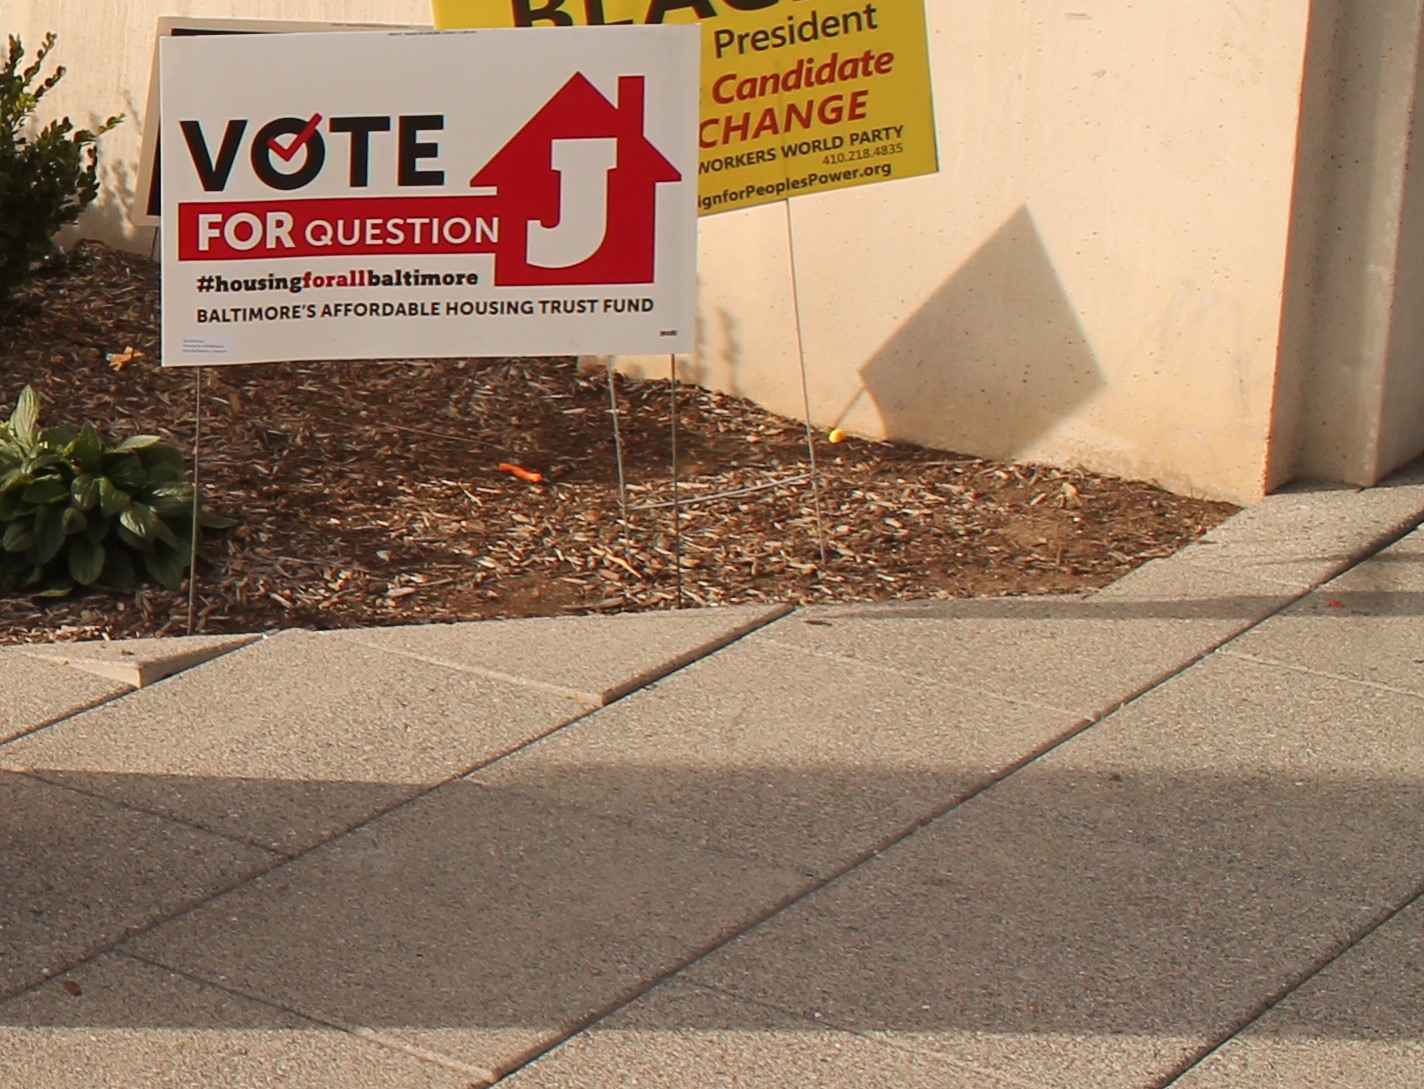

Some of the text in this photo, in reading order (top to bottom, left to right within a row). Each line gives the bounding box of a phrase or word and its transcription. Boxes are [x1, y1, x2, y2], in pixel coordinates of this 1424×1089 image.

[713, 3, 878, 60] President
[711, 50, 895, 105] Candidate
[699, 90, 869, 149] CHANGE
[780, 136, 844, 159] WORLD
[849, 124, 904, 147] PARTY
[179, 112, 446, 193] VOTE
[821, 142, 904, 166] 410.218.4835
[525, 136, 619, 270] J
[698, 162, 892, 210] ignforPeoplesPower.org
[197, 210, 501, 252] FOR QUESTION
[196, 268, 480, 295] #housingforallbaltimore
[196, 297, 655, 324] BALTIMORE'S AFFORDABLE HOUSING TRUST FUND
